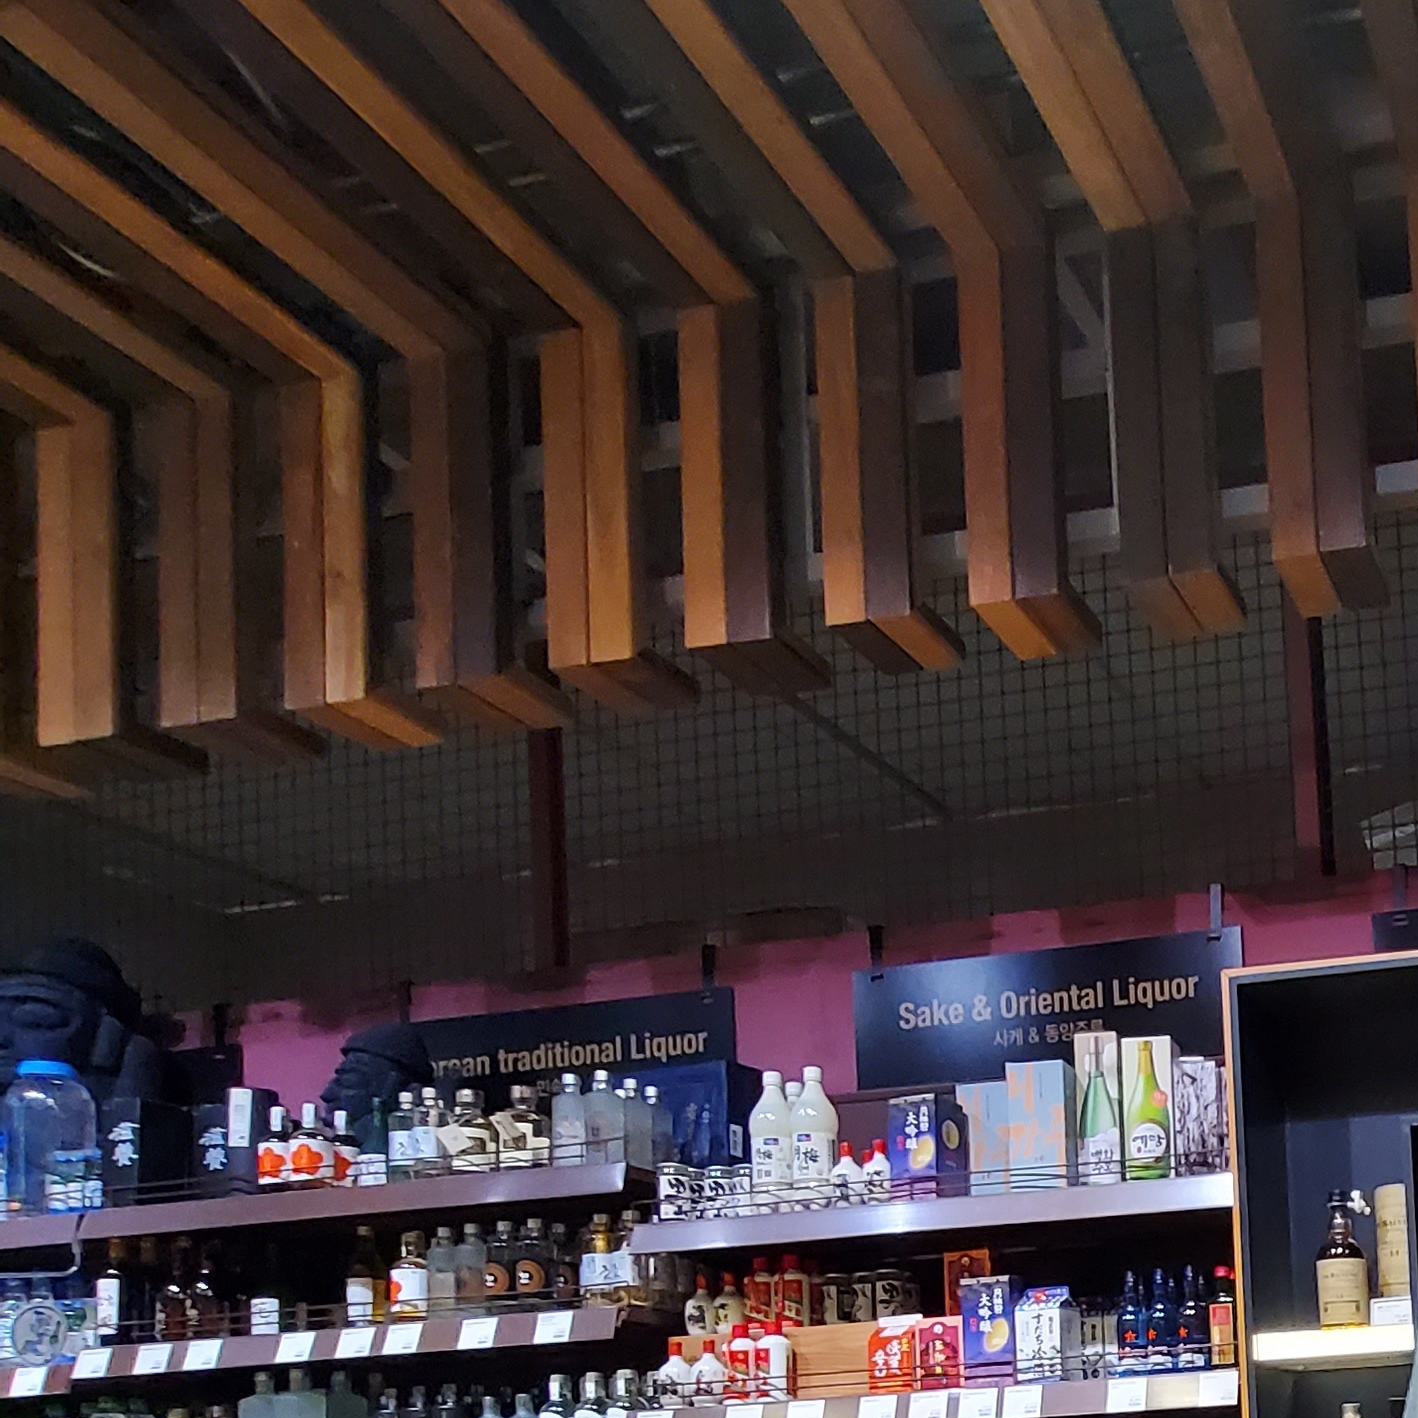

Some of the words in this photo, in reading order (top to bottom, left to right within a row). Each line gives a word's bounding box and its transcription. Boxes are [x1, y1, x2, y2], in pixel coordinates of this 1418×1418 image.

[898, 998, 965, 1031] Sake
[971, 994, 992, 1022] &
[1001, 981, 1104, 1019] Oriental
[1113, 975, 1199, 1009] Liquor
[430, 1055, 491, 1079] rean
[498, 1034, 622, 1073] traditional
[630, 1030, 708, 1064] Liquor
[993, 1027, 1024, 1048] 사케
